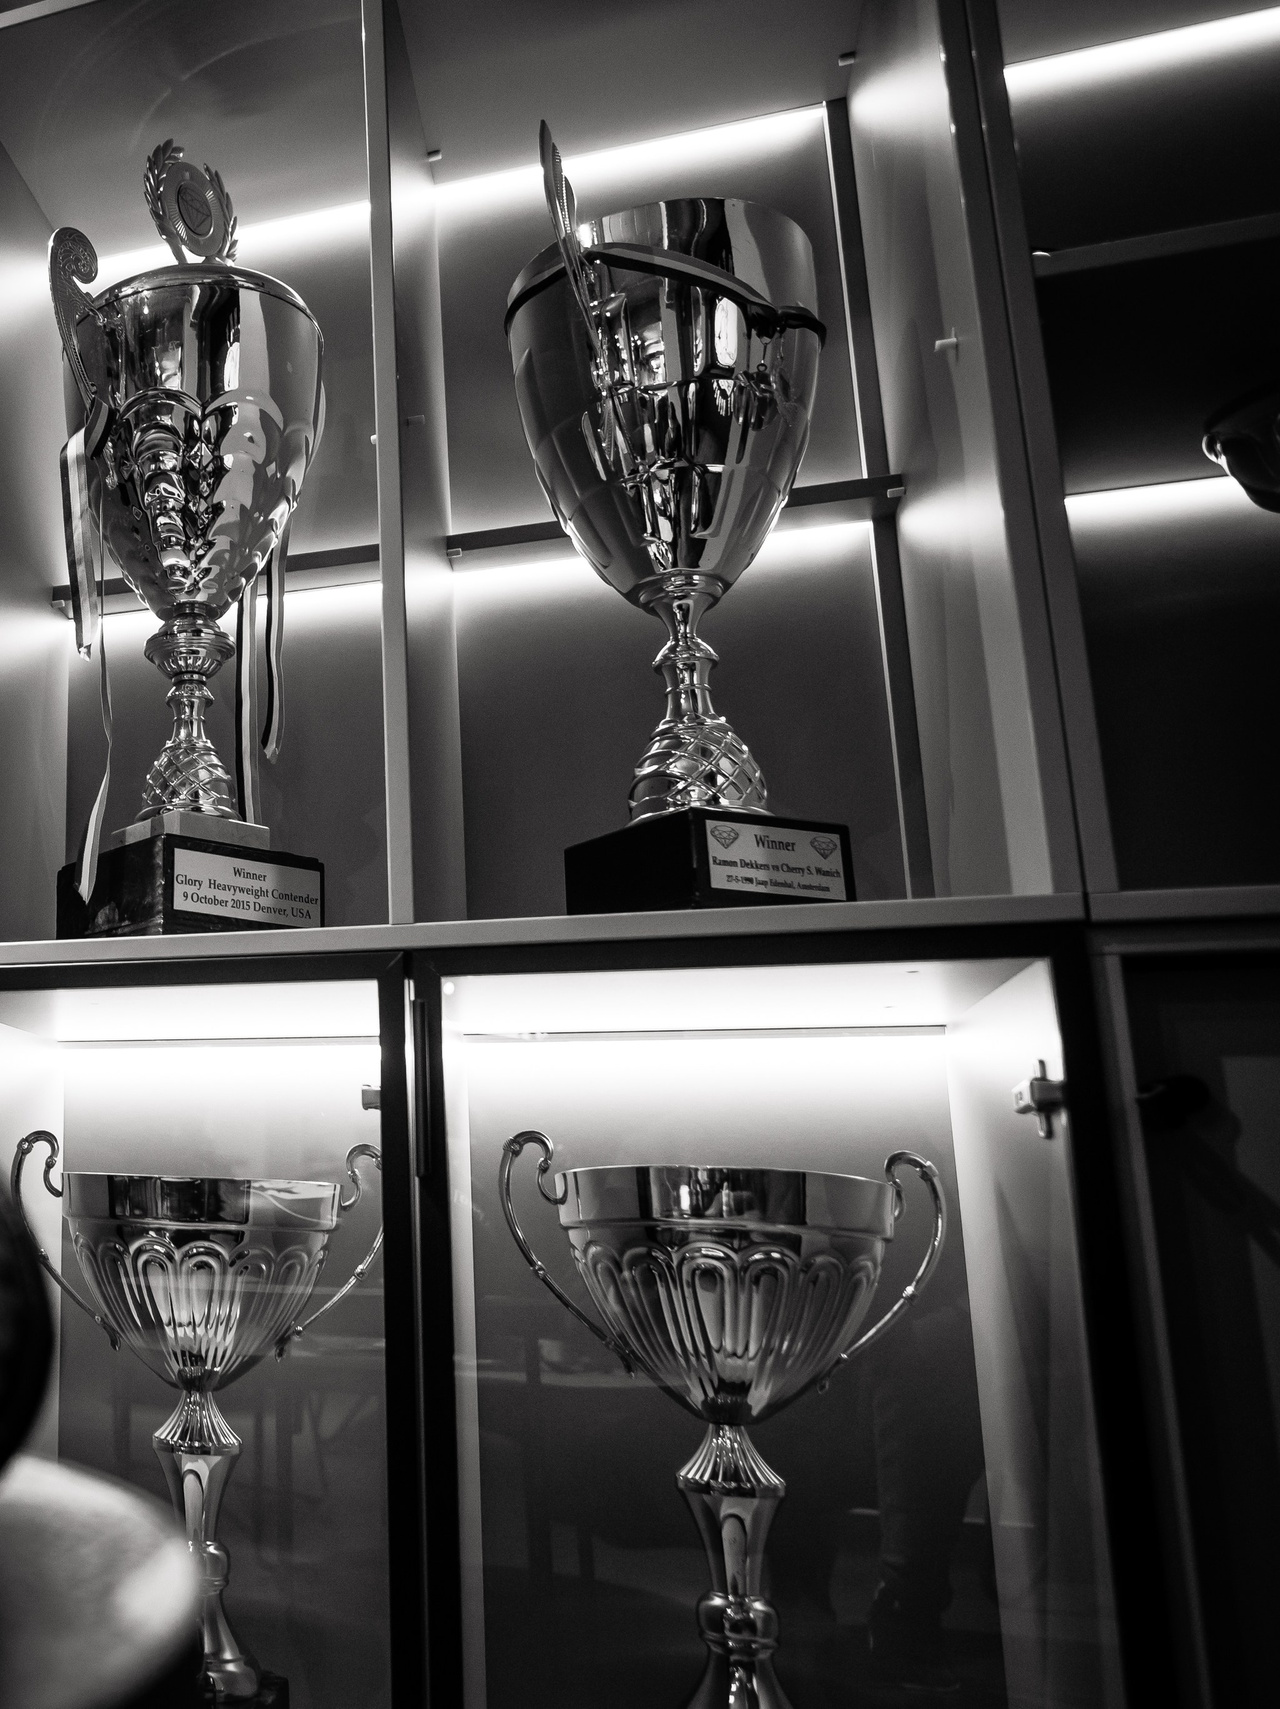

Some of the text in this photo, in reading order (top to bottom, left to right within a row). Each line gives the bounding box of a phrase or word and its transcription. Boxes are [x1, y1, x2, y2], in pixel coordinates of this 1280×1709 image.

[754, 834, 796, 851] Winner
[232, 866, 267, 882] Winner
[712, 856, 738, 868] Ramon
[739, 859, 770, 871] Dekkers
[781, 862, 805, 877] Cherry
[175, 873, 318, 905] Glory Heavyweight Contender
[182, 891, 312, 919] 9 October 2015 Denver, USA
